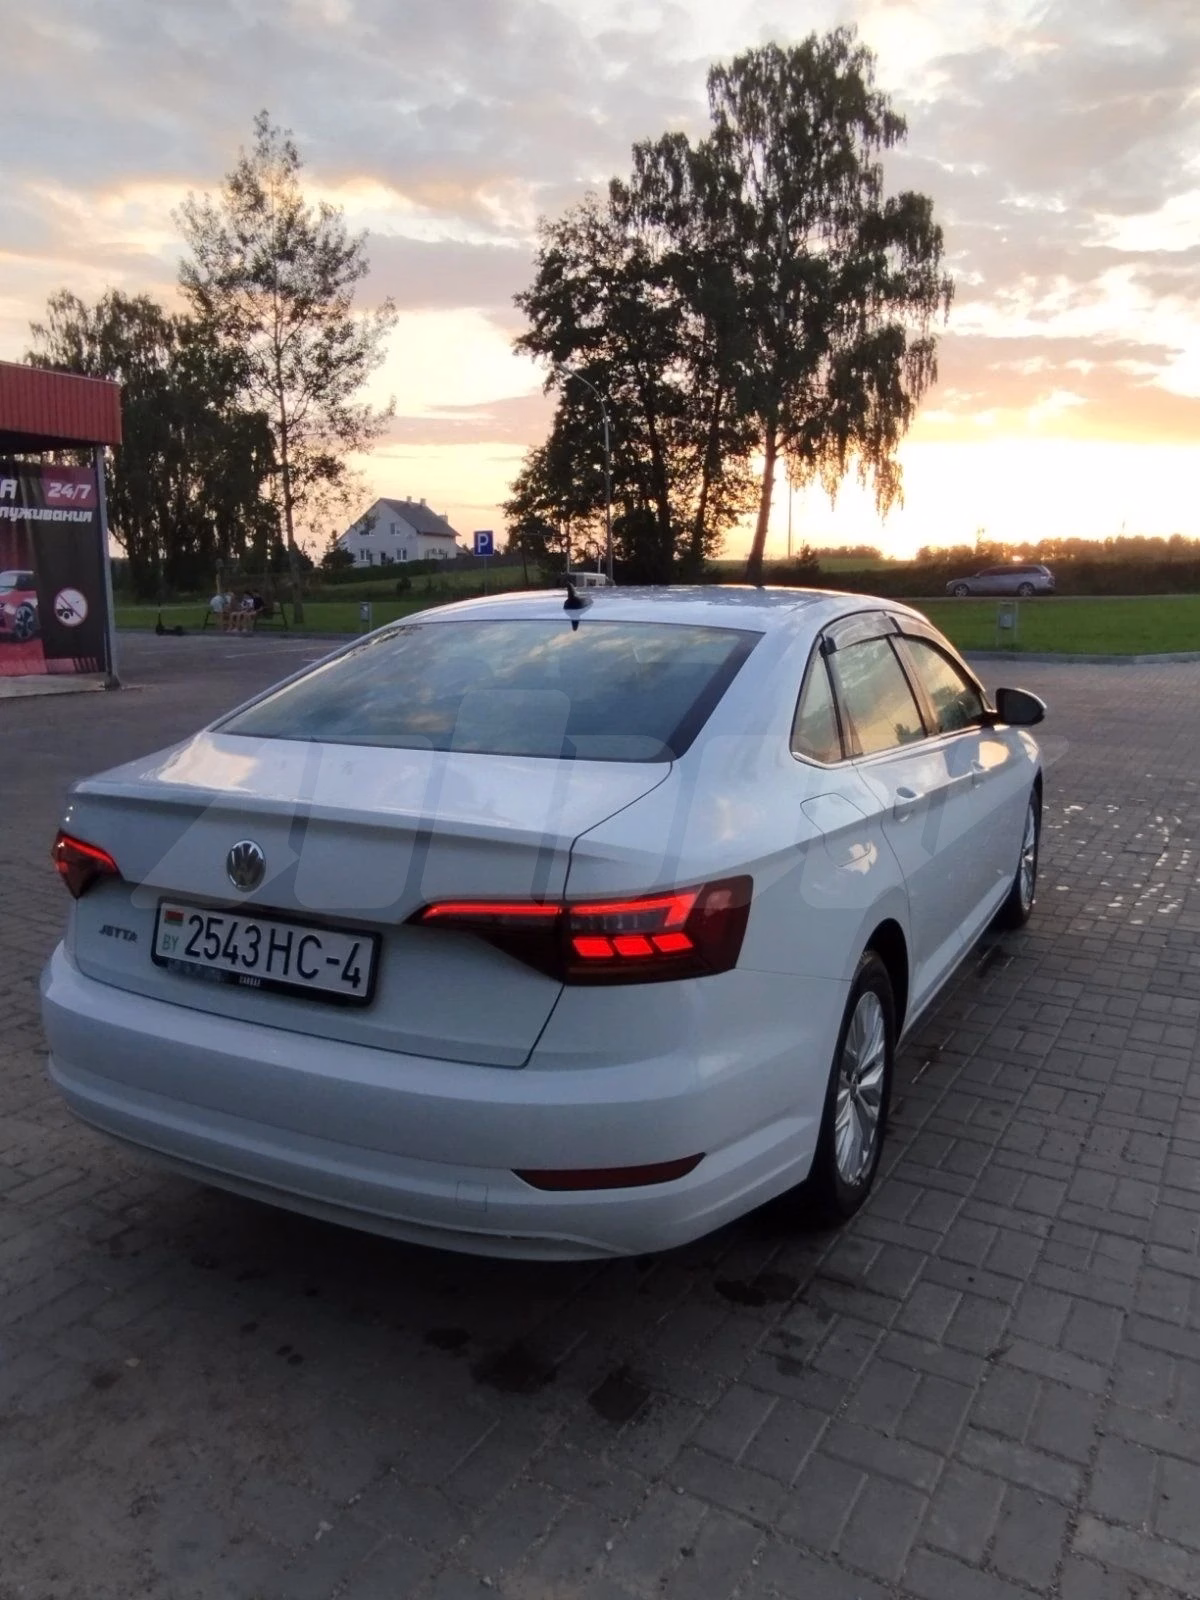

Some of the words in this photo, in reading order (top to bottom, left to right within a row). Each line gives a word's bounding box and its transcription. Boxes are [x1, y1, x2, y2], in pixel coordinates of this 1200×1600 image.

[48, 482, 91, 499] 24/7
[477, 533, 489, 553] P
[161, 934, 179, 952] BY
